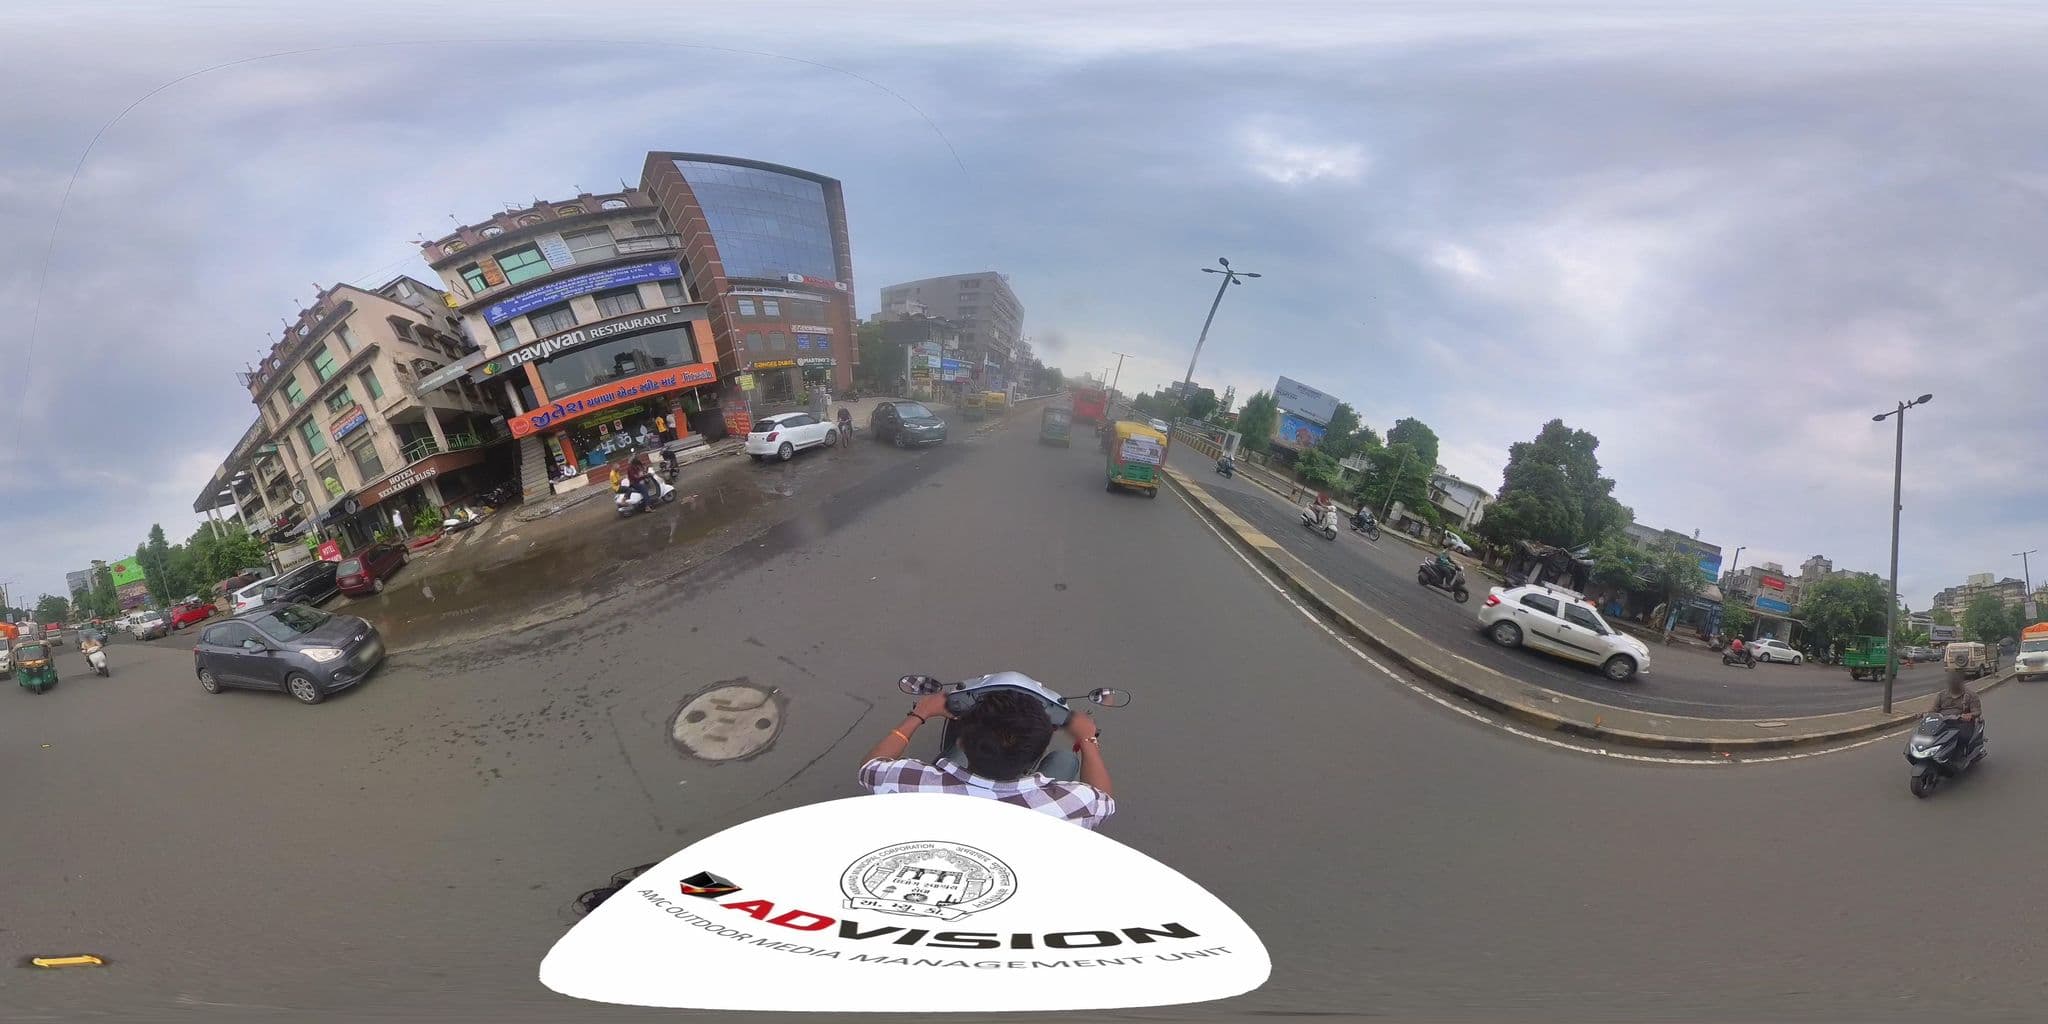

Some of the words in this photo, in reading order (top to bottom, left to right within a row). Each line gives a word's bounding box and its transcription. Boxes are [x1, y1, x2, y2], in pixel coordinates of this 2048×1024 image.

[508, 330, 586, 366] navjivan
[590, 314, 668, 338] RESTAURANT
[388, 468, 416, 485] HOTEL
[414, 467, 437, 482] BLISS
